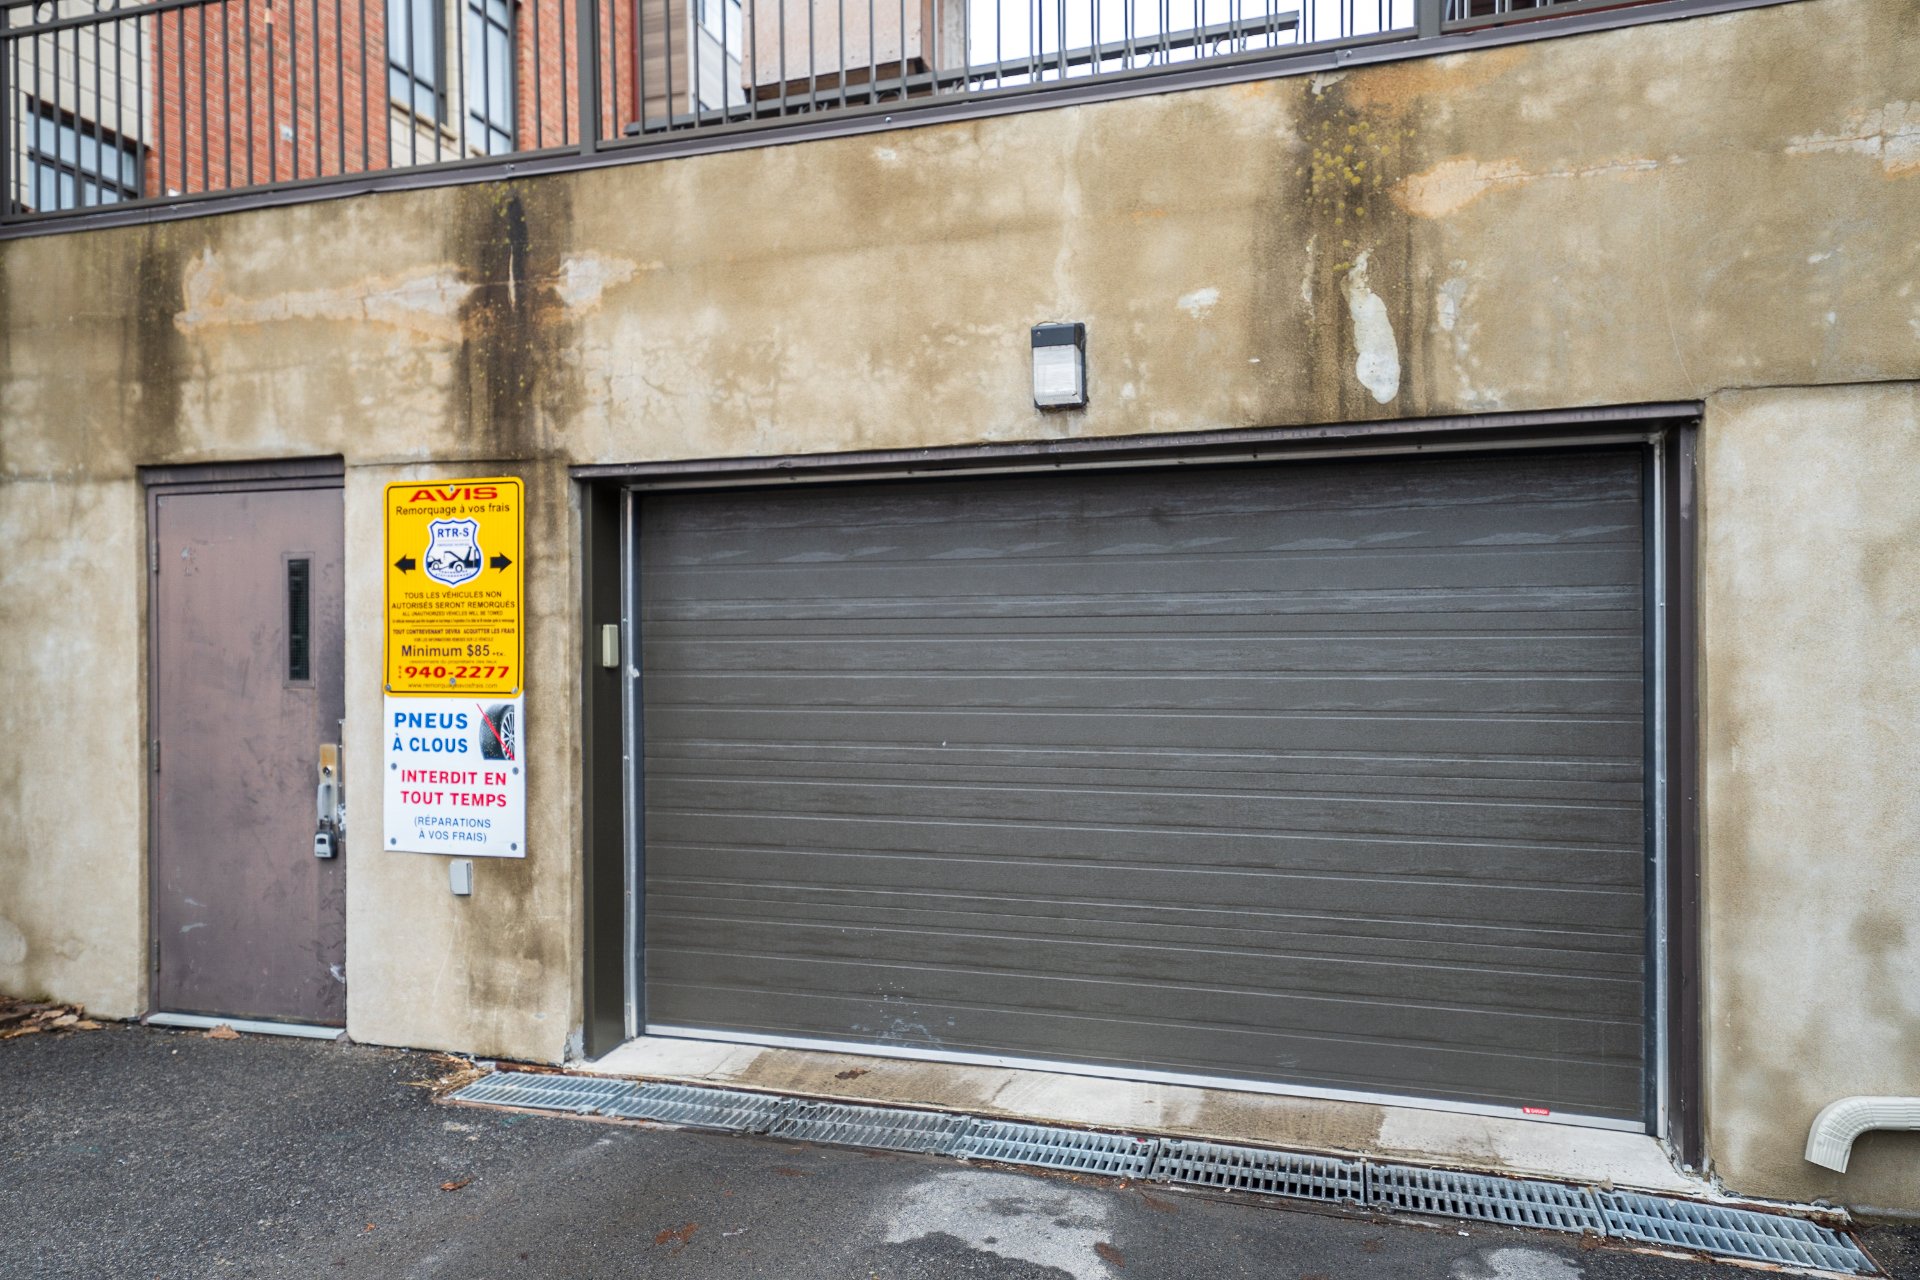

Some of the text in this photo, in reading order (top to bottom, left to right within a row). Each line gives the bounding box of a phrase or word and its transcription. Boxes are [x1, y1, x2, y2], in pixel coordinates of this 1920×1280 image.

[409, 487, 498, 502] AVIS
[396, 503, 510, 516] Remorquage à vos frais
[438, 528, 469, 538] RTR-S
[442, 590, 483, 598] VÉHICULES
[468, 600, 515, 608] REMORQUÉS
[402, 645, 462, 656] Minimum
[467, 644, 490, 657] $85
[405, 666, 509, 678] 940-2277
[394, 712, 468, 729] PNEUS
[393, 733, 468, 753] À CLOUS
[401, 770, 506, 785] INTERDIT EN
[400, 791, 507, 807] TOUT TEMPS
[414, 814, 491, 828] (RÉPARATIONS
[419, 830, 487, 842] À VOS FRAIS)
